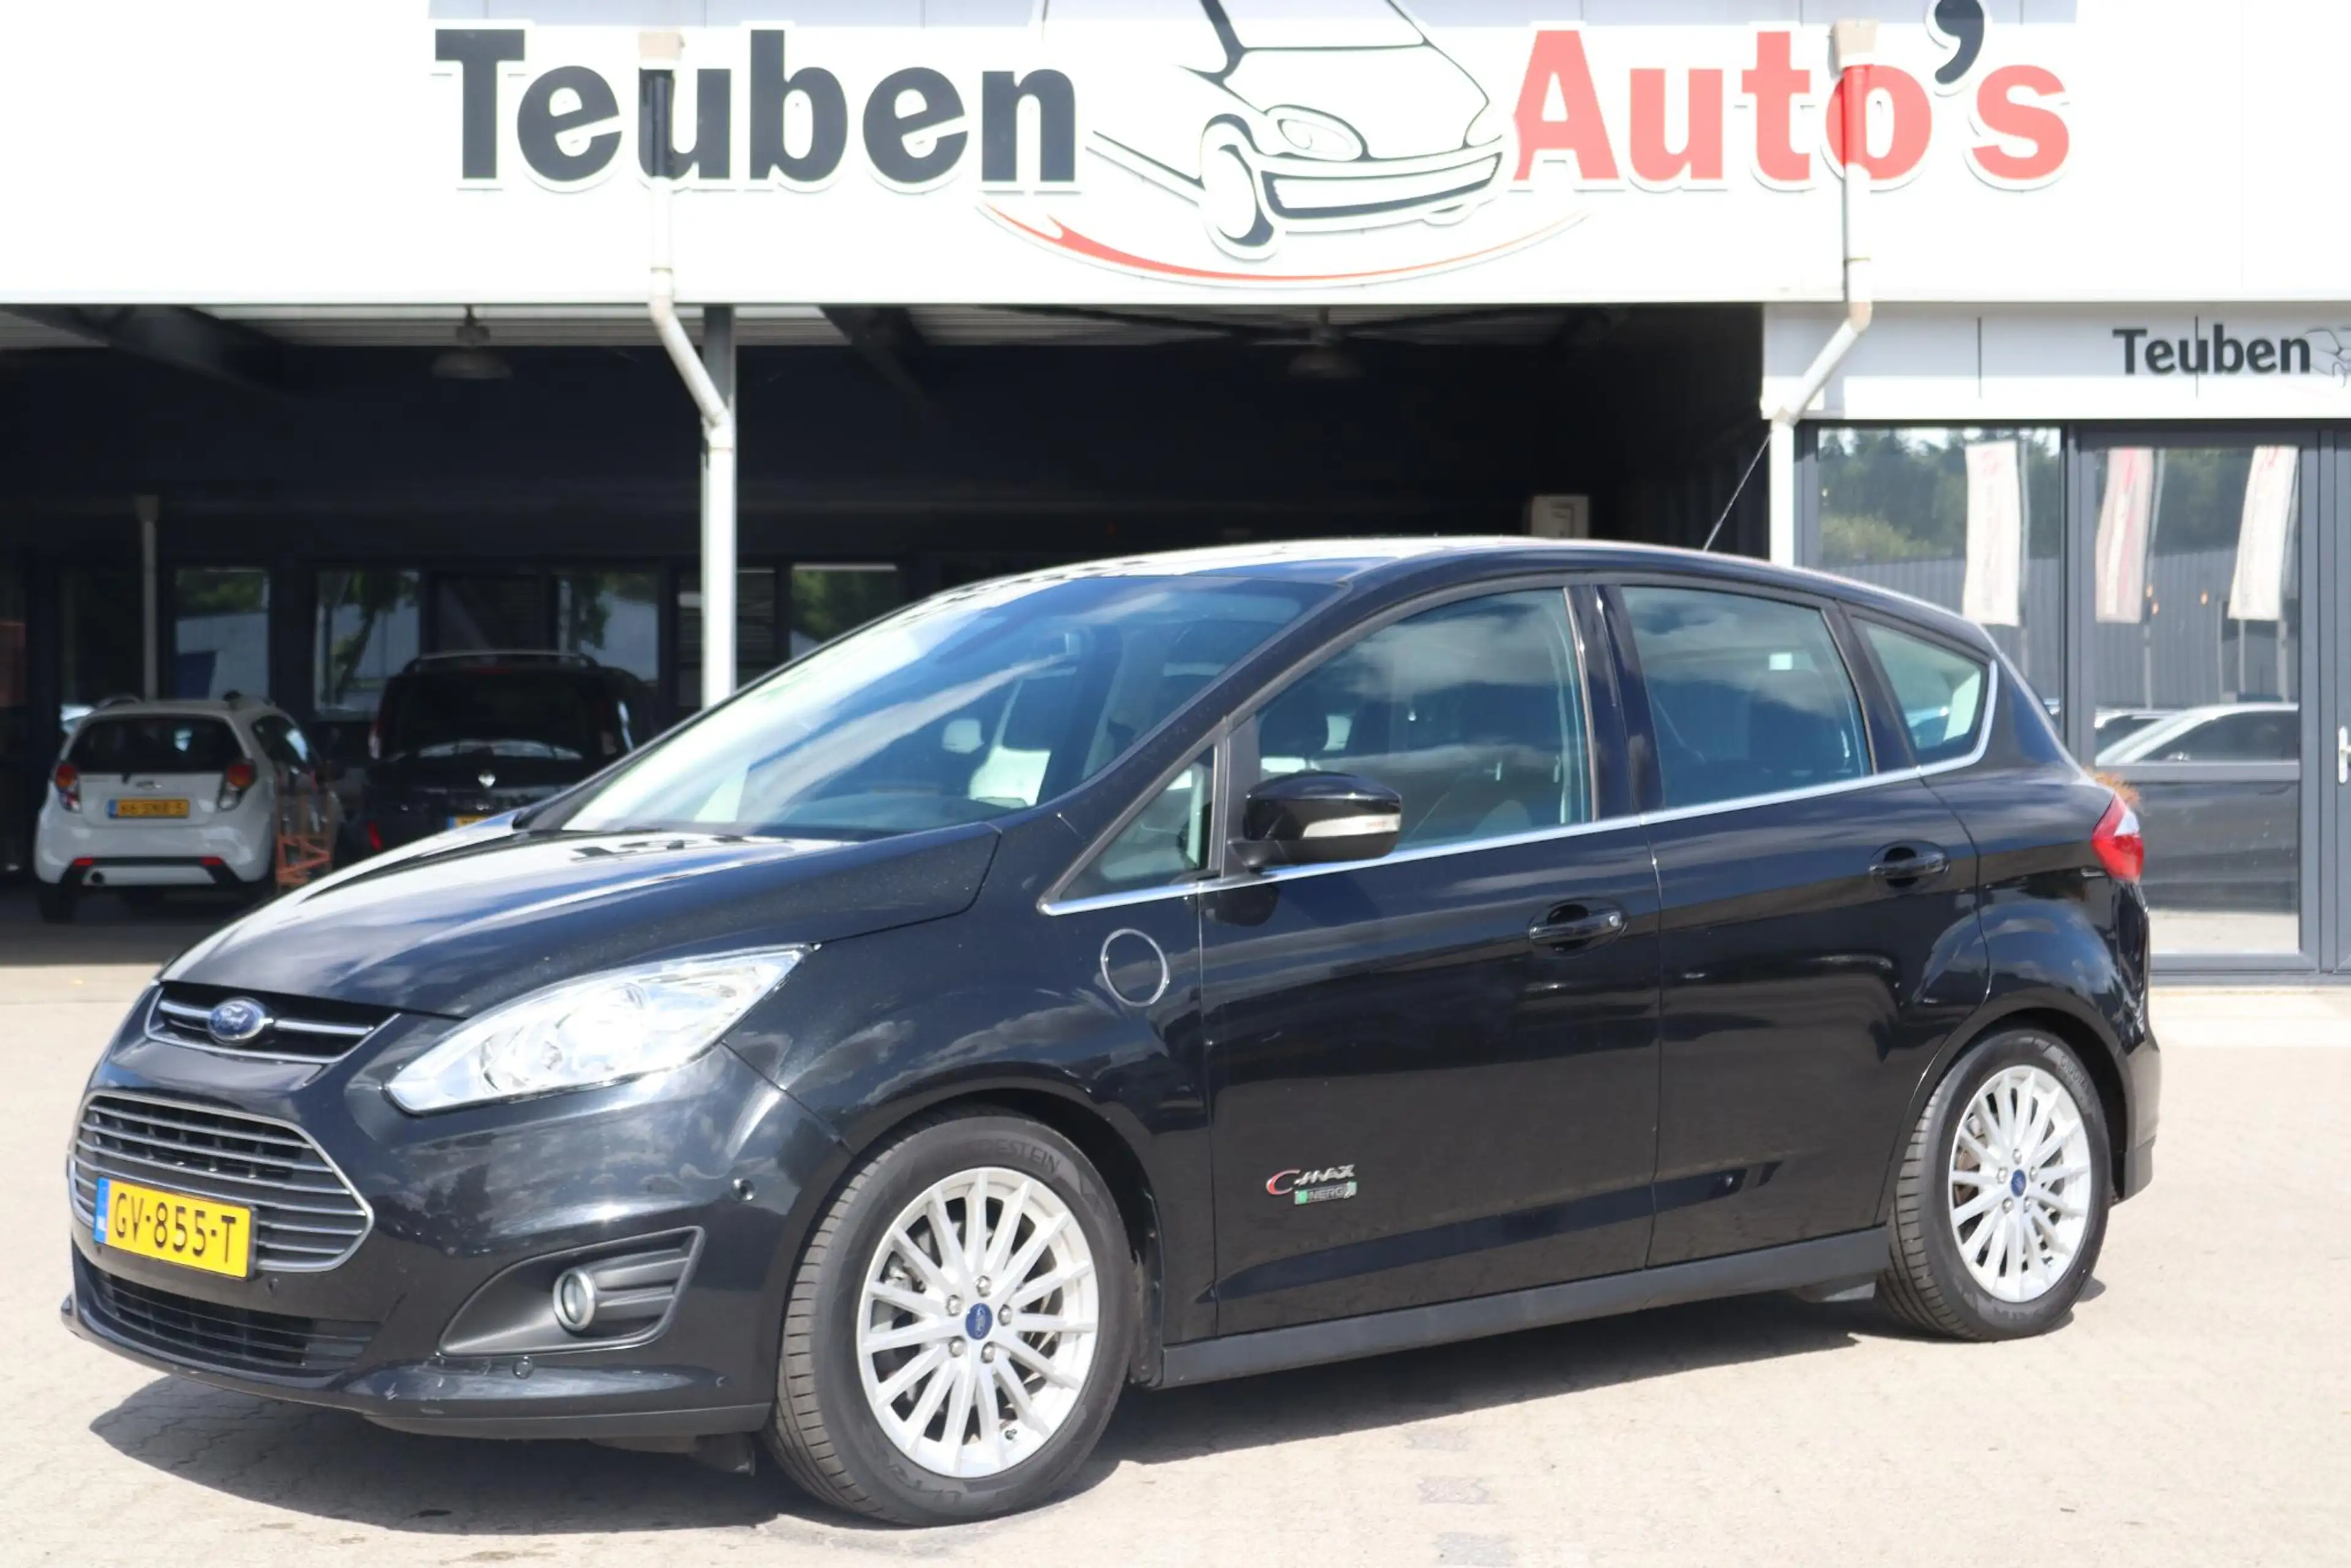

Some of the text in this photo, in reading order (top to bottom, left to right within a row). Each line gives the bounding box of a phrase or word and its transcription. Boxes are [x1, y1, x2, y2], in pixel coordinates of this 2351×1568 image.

[435, 0, 2070, 181] Teuben Auto's
[2112, 322, 2311, 375] Teuben
[114, 1192, 237, 1264] GV-855-T
